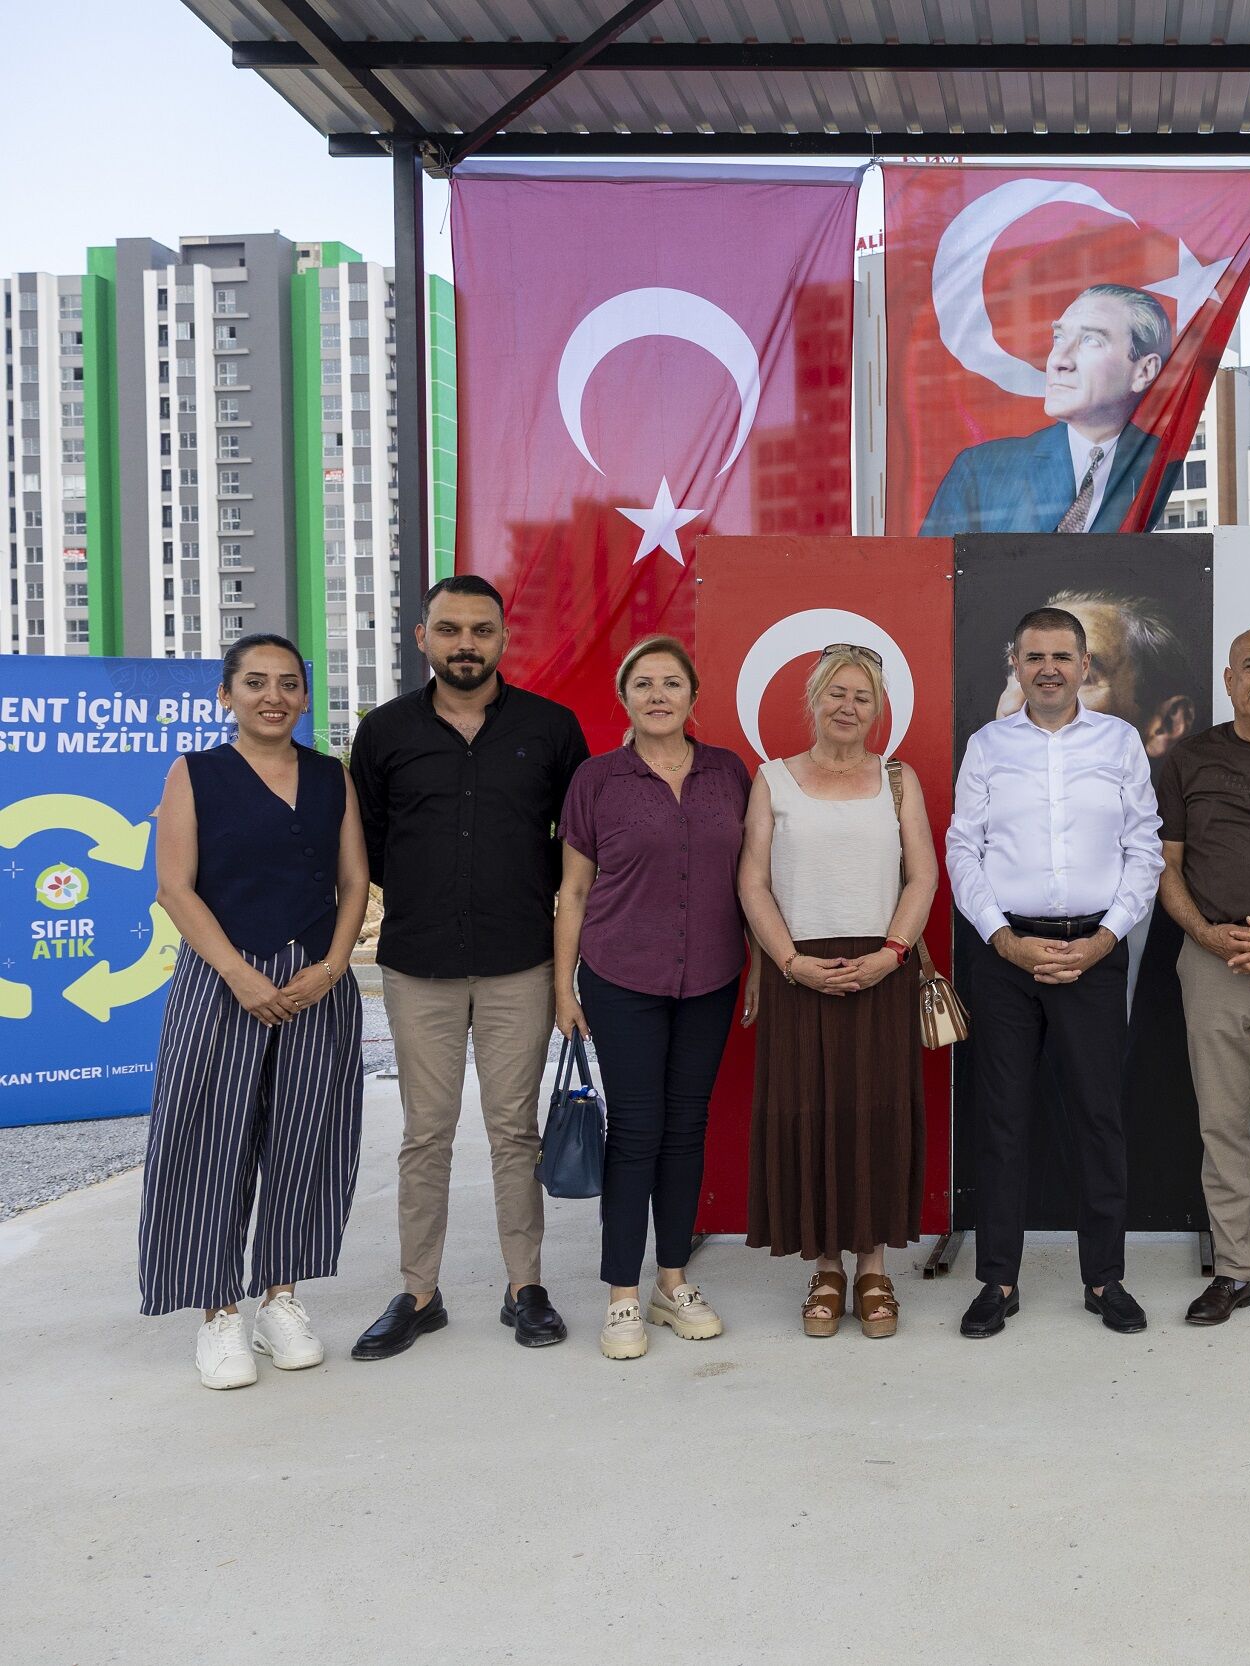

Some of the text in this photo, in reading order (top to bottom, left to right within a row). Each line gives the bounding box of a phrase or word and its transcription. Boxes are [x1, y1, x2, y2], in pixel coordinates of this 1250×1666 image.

[77, 691, 148, 730] İÇİN
[57, 726, 168, 753] MEZİTLİ
[176, 727, 230, 752] BİZİ
[31, 918, 95, 939] SIFIR
[32, 937, 95, 960] ATIK
[35, 1066, 102, 1083] TUNCER
[111, 1062, 153, 1076] MEZİTLİ
